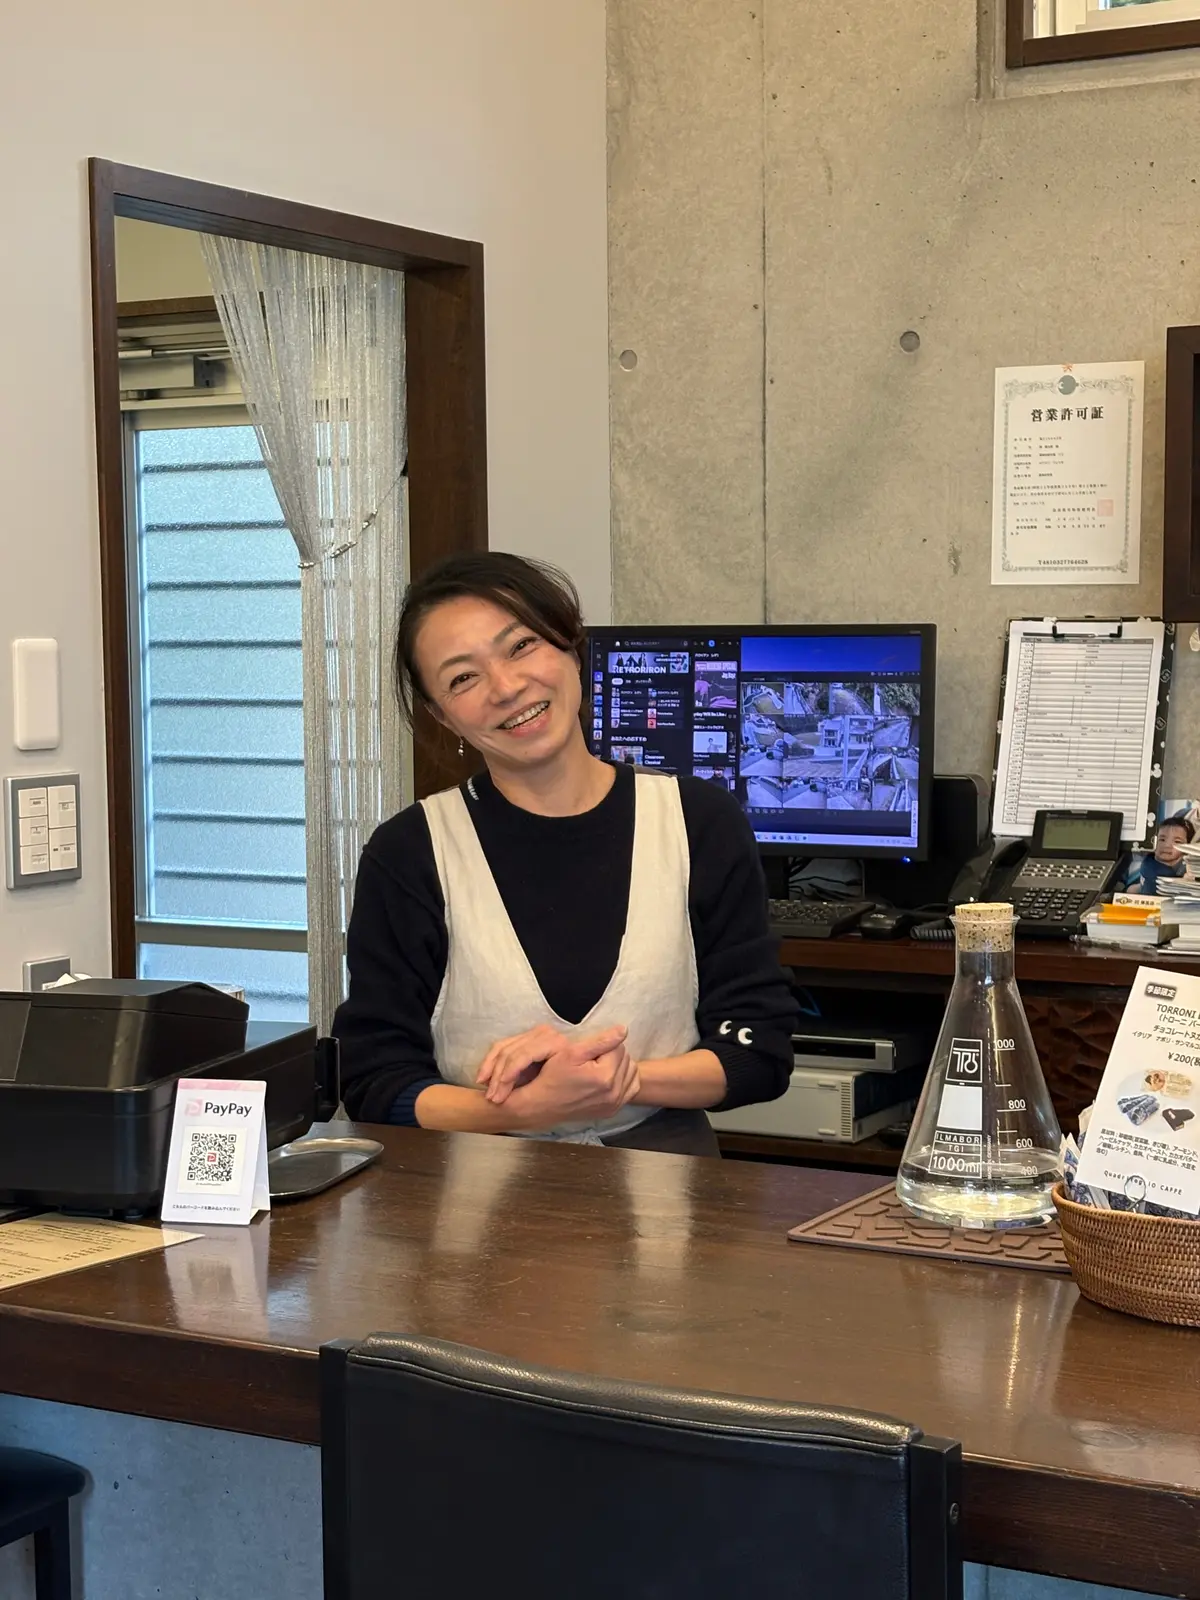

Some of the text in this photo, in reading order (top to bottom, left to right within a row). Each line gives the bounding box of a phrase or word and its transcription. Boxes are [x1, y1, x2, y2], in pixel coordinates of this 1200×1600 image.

[1031, 406, 1104, 422] 営業許可証
[1156, 1003, 1197, 1019] TORRONI
[1132, 1030, 1153, 1040] イタリア
[993, 1038, 1015, 1049] 1000
[1008, 1099, 1026, 1109] 800
[204, 1102, 252, 1118] PayPay
[935, 1132, 980, 1145] ILMABOR
[1015, 1138, 1033, 1149] 600
[948, 1144, 964, 1153] TGI
[932, 1155, 980, 1173] 1000ml
[1020, 1165, 1038, 1176] 400
